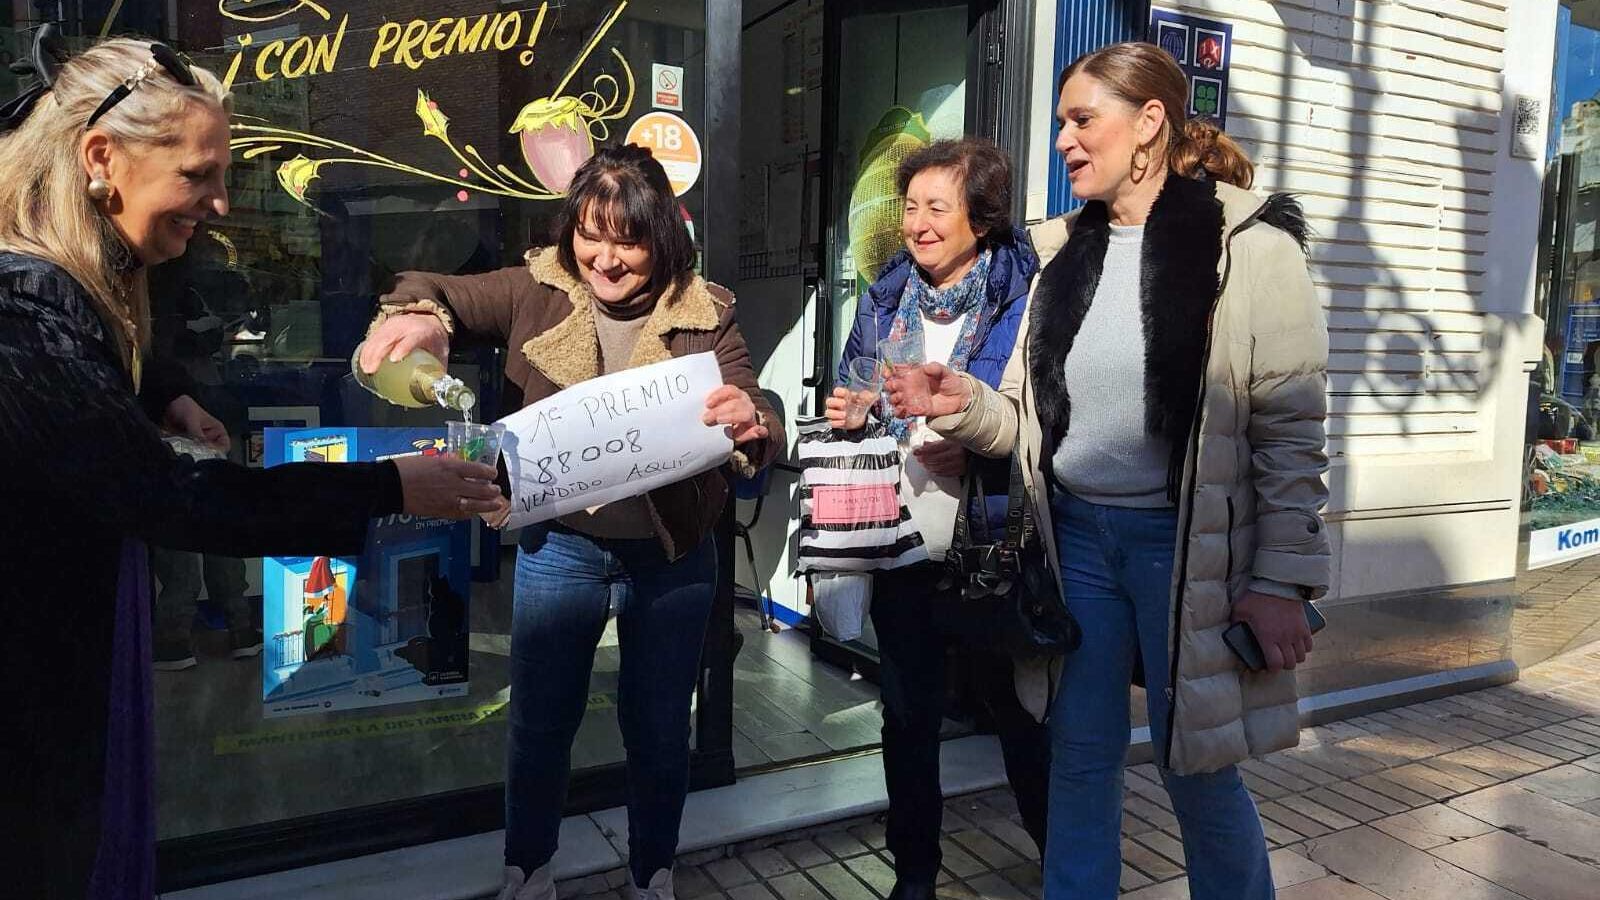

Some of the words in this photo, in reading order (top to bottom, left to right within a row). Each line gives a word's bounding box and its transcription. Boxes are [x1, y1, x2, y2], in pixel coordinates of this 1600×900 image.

[369, 1, 549, 69] PREMIO!
[641, 122, 683, 151] +18
[577, 373, 690, 428] PREMIO
[384, 710, 480, 730] DISTANCIA
